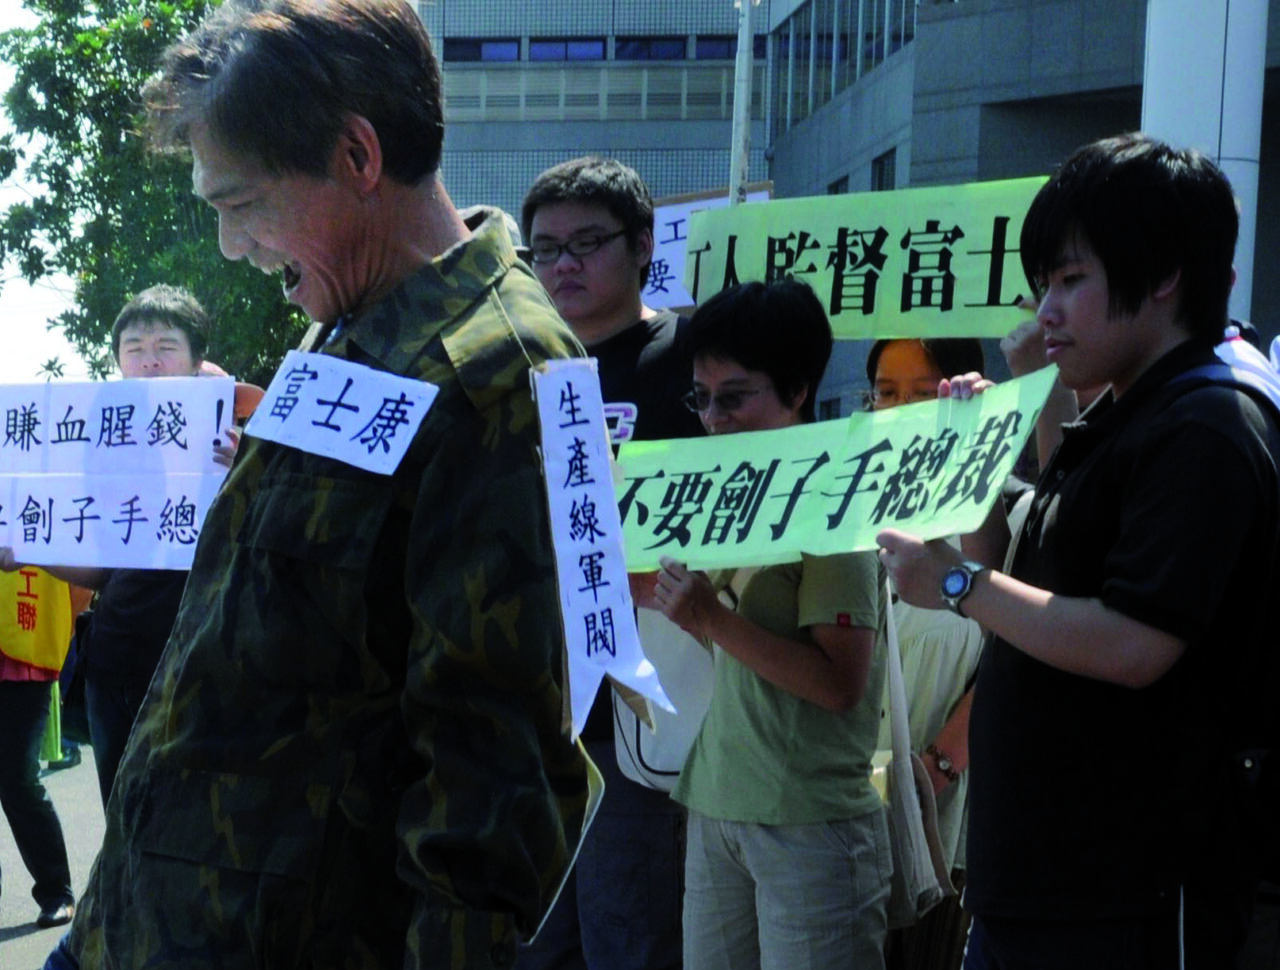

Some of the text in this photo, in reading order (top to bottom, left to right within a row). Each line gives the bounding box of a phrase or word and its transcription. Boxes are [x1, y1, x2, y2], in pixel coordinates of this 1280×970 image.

[269, 362, 415, 454] 富士康
[558, 381, 617, 658] 生產線軍閥
